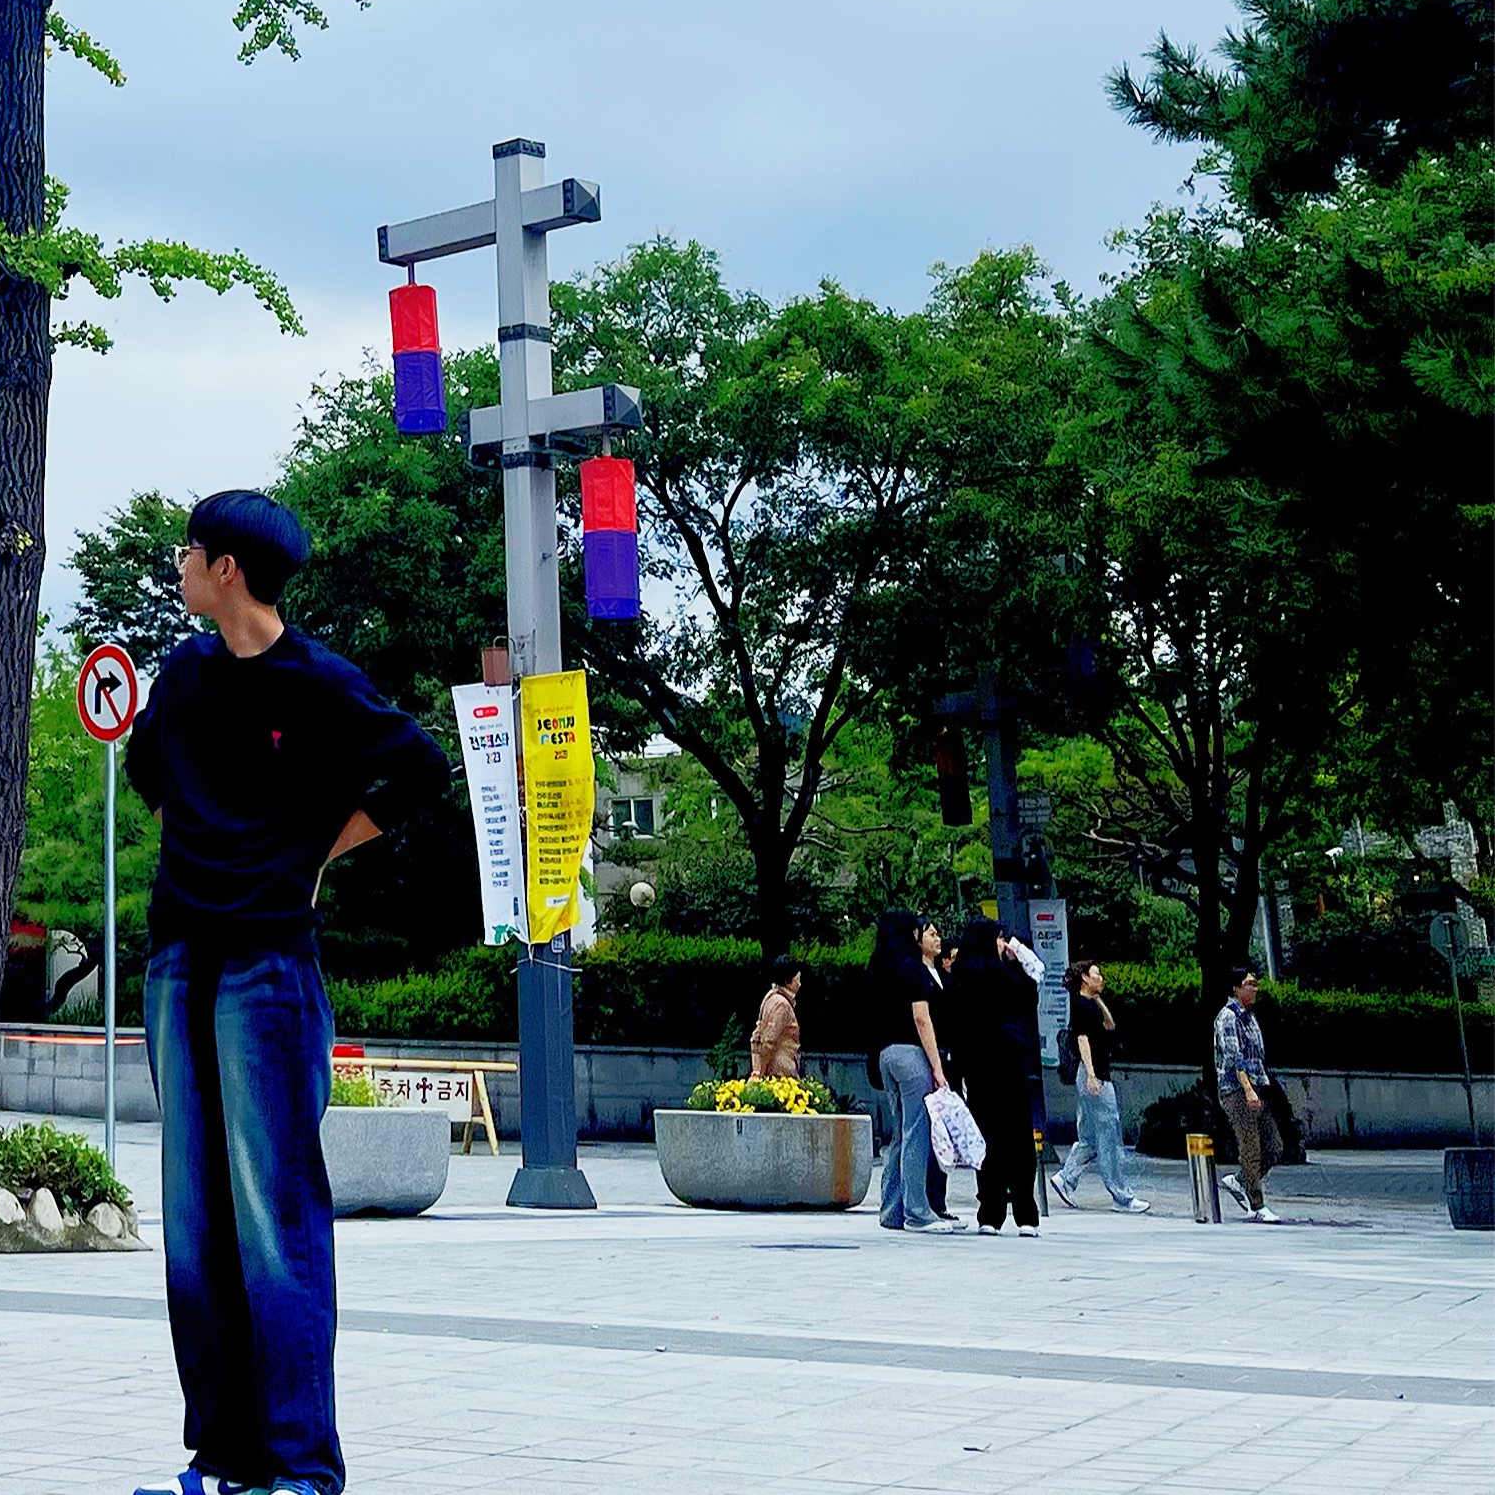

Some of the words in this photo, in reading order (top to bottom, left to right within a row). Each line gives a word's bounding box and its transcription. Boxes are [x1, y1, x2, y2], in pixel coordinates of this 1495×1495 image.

[541, 731, 575, 745] FESTA
[379, 1078, 411, 1100] 주차
[437, 1080, 469, 1101] 금지
